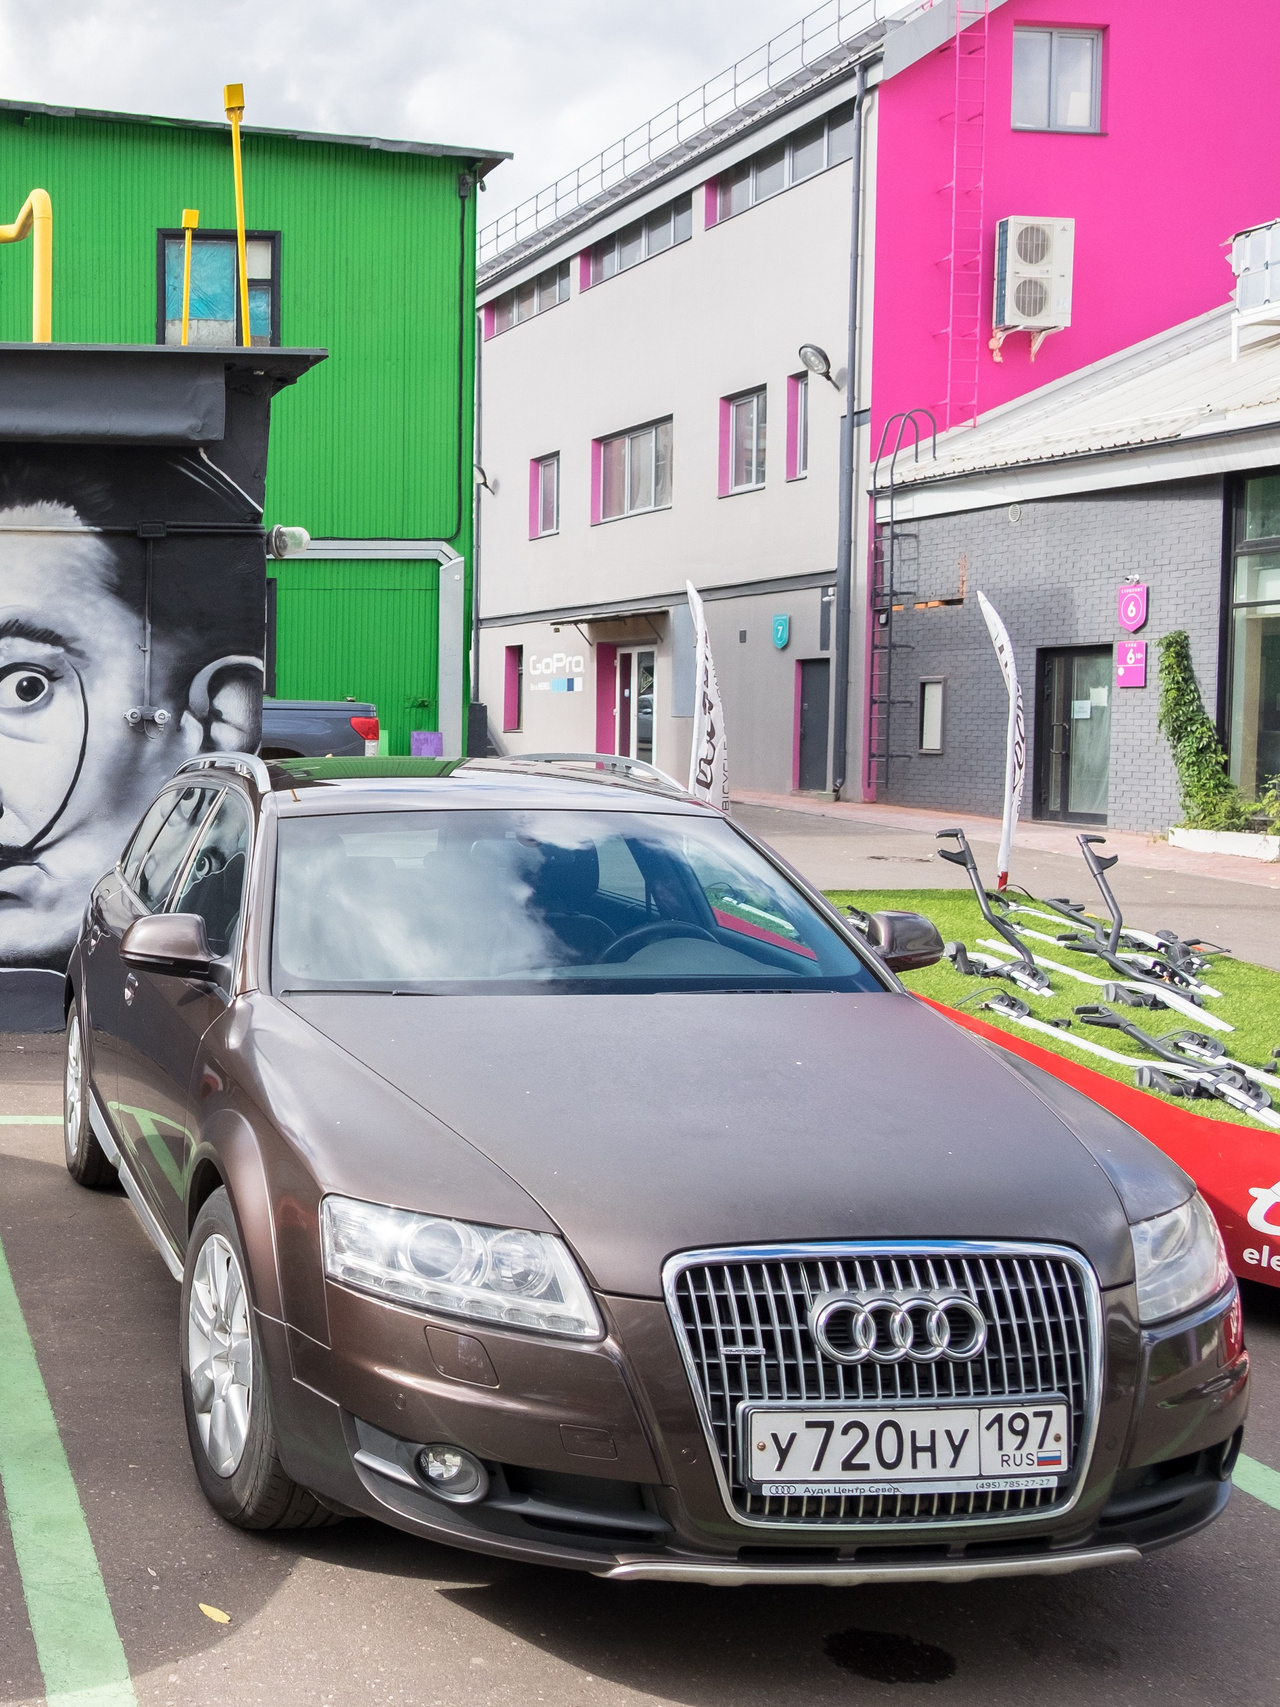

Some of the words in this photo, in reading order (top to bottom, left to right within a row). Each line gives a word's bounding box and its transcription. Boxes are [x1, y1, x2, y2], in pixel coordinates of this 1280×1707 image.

[1127, 600, 1136, 618] 6
[777, 625, 783, 638] 7
[529, 652, 585, 675] GoPro
[1126, 648, 1135, 665] 6
[985, 1410, 1053, 1451] 197
[1001, 1452, 1036, 1468] RUS
[803, 1486, 831, 1496] Ауди
[833, 1486, 866, 1496] Центр
[868, 1485, 902, 1495] Север
[975, 1481, 1001, 1490] (495)
[1003, 1479, 1050, 1488] 785-27-27
